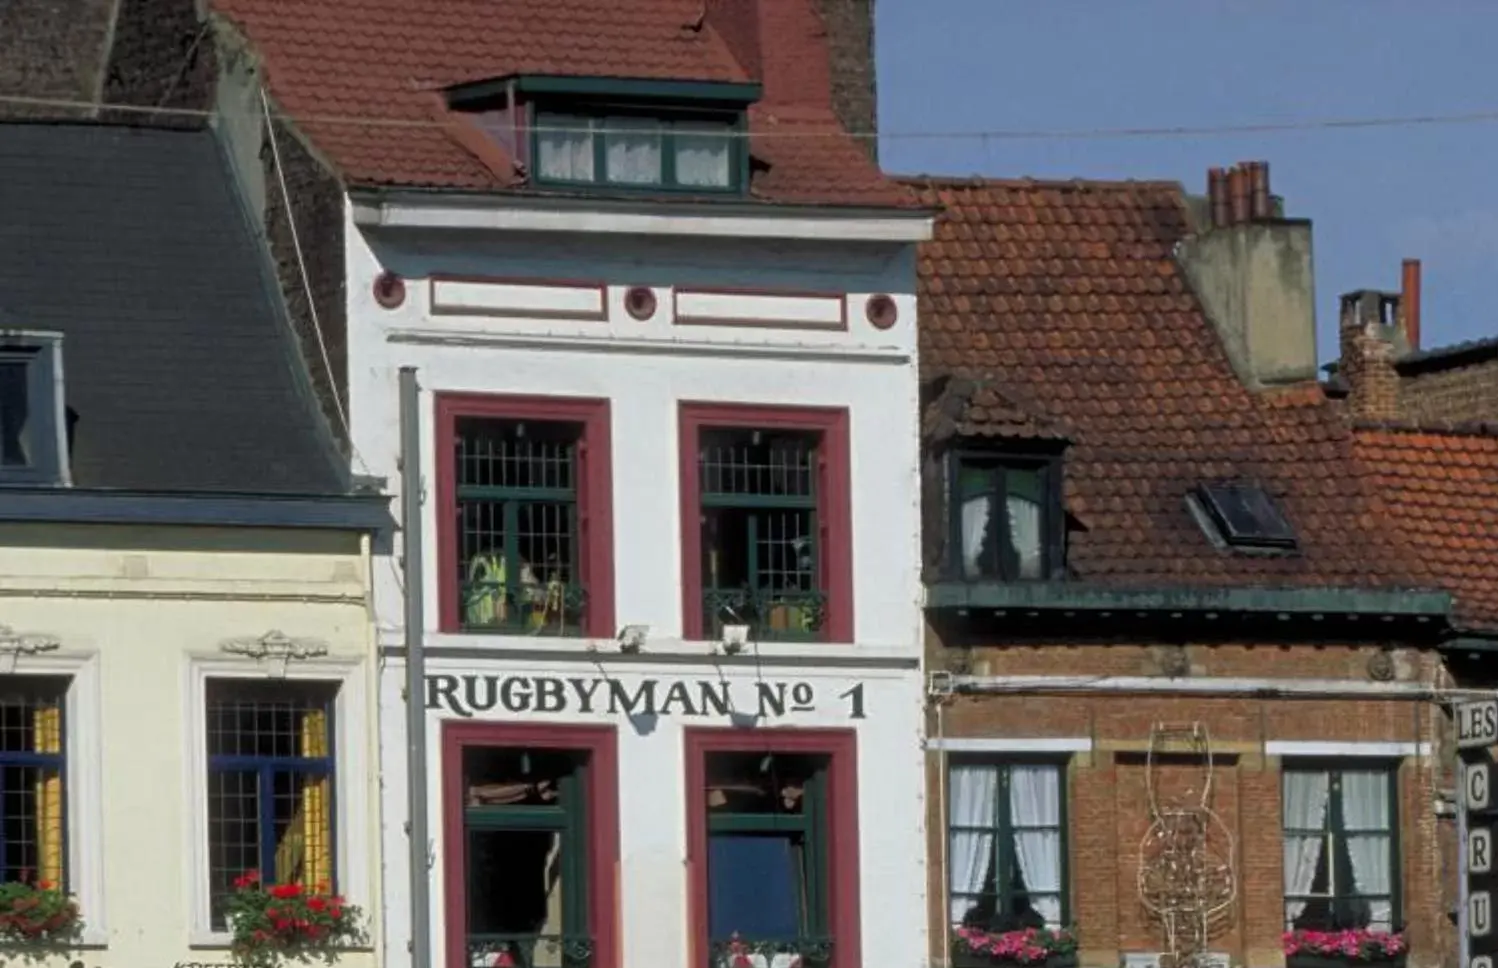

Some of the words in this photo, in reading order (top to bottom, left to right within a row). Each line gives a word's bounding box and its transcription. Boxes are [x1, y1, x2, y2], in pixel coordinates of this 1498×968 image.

[424, 674, 737, 718] RUGBYMAN
[838, 682, 866, 719] 1
[1457, 706, 1497, 740] LES
